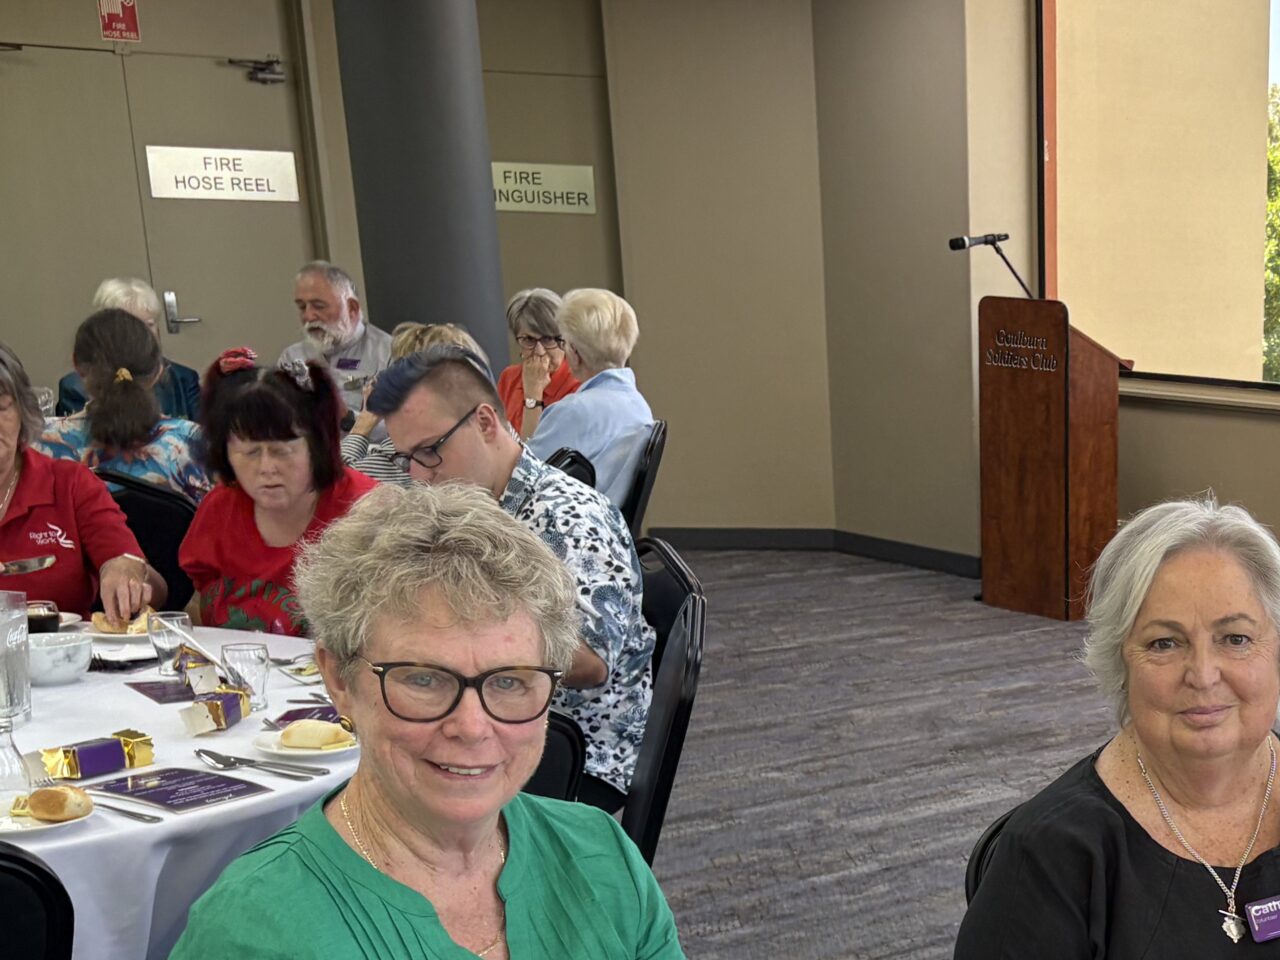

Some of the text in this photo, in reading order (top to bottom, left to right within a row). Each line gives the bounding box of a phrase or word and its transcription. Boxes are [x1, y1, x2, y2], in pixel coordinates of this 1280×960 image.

[203, 156, 244, 172] FIRE
[174, 175, 276, 192] HOSE REEL
[503, 170, 542, 185] FIRE
[995, 329, 1047, 350] Goulburn
[1030, 353, 1057, 372] Club
